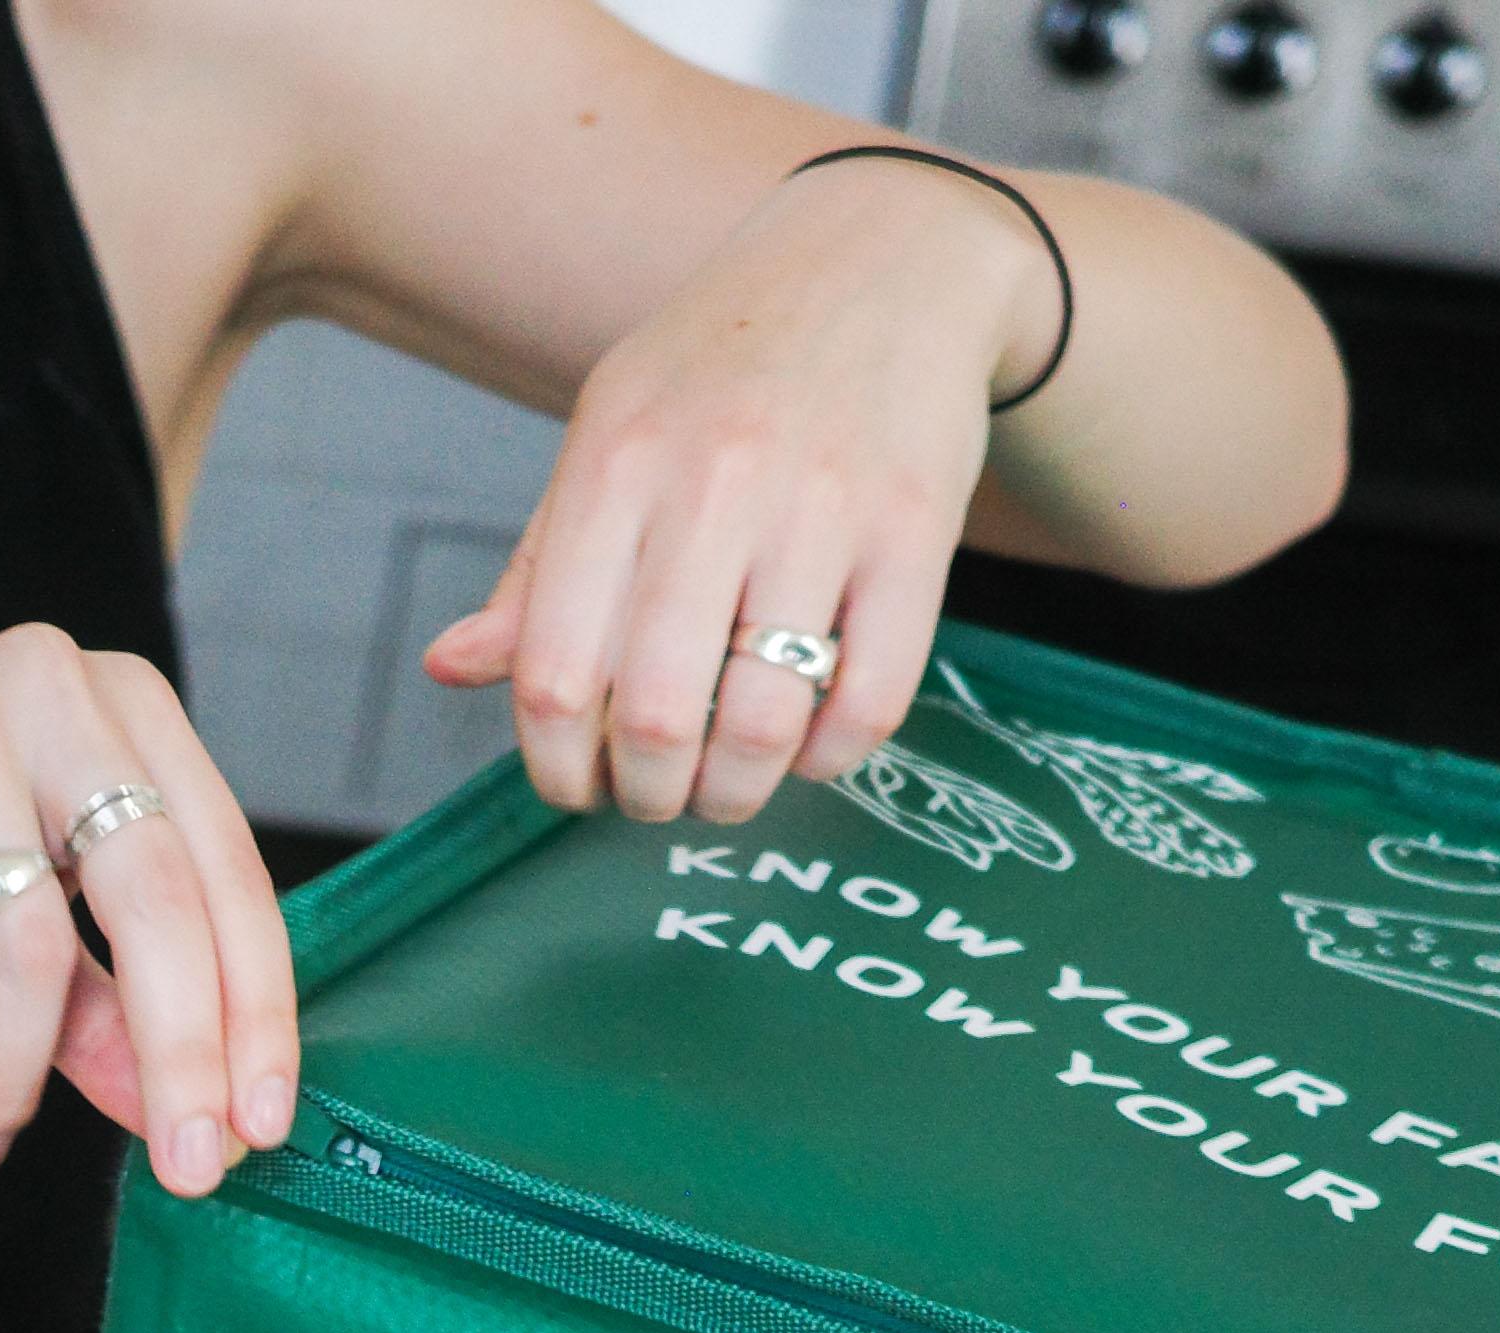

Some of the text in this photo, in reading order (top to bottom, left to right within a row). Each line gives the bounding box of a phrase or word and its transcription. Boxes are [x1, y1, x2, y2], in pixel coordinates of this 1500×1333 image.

[654, 906, 1036, 1040] KNOW
[1055, 1050, 1381, 1223] YOUR
[668, 845, 1024, 958] KNOW
[1047, 964, 1348, 1118] YOUR
